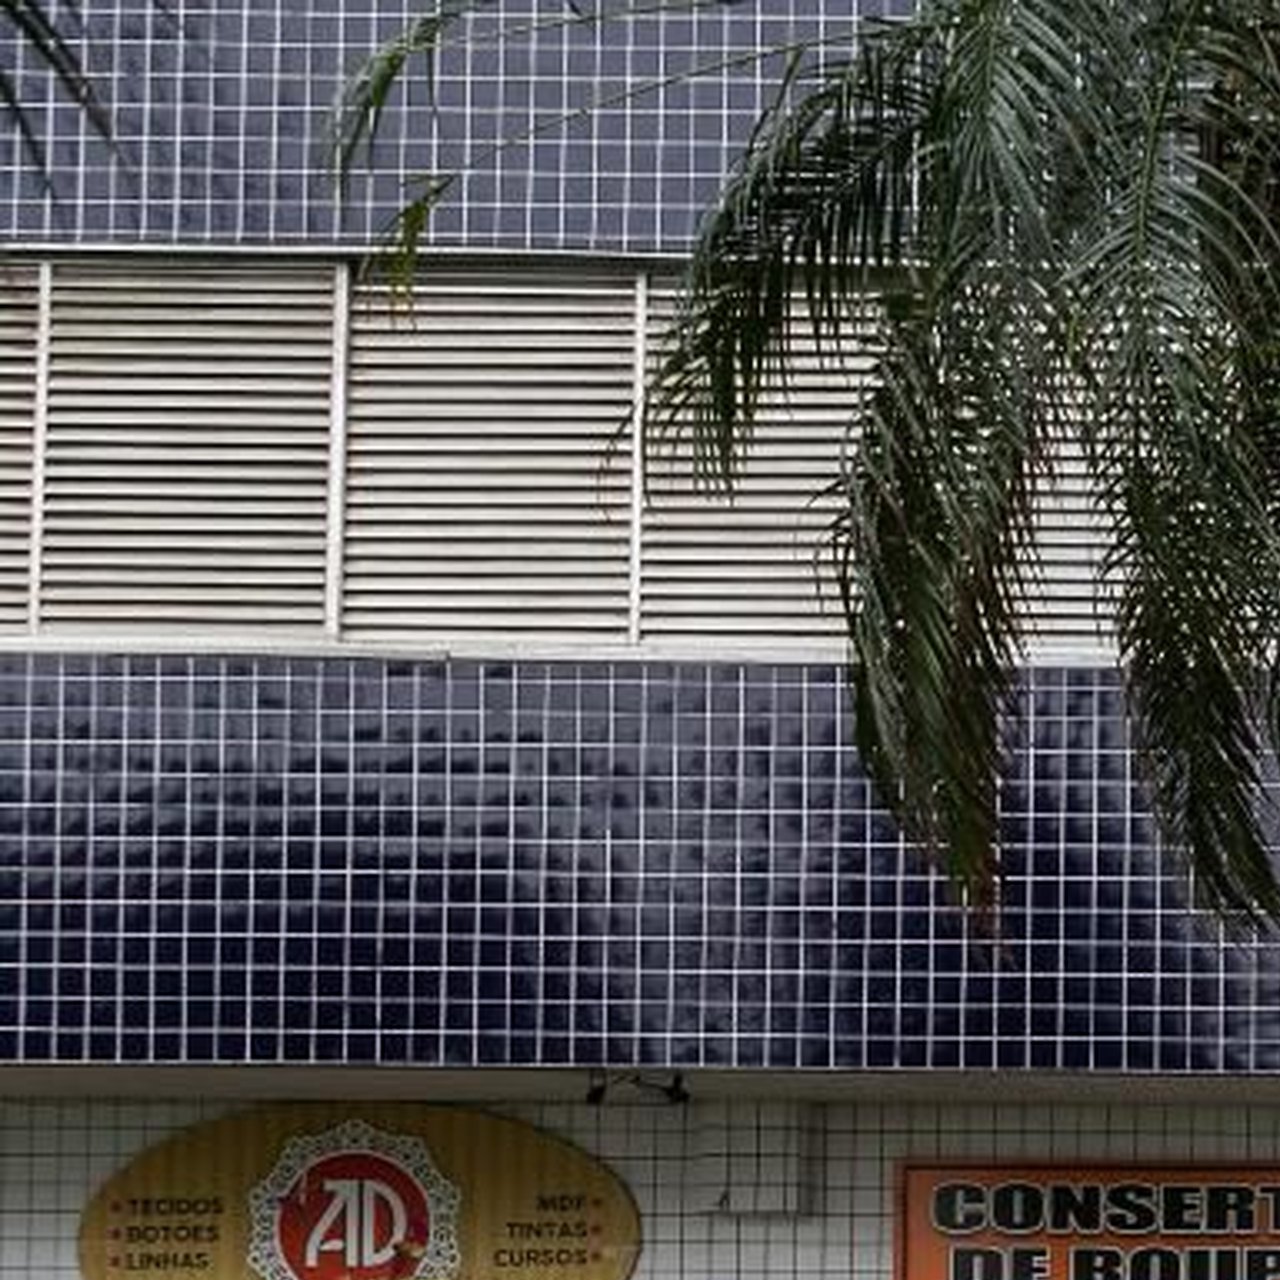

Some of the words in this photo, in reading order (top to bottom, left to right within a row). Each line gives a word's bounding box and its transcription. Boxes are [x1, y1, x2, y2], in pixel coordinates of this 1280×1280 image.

[126, 1198, 223, 1215] TECIDOS
[305, 1178, 407, 1267] AD
[506, 1222, 588, 1239] TINTAS
[125, 1253, 210, 1271] LINHAS
[493, 1249, 588, 1268] CURSOS
